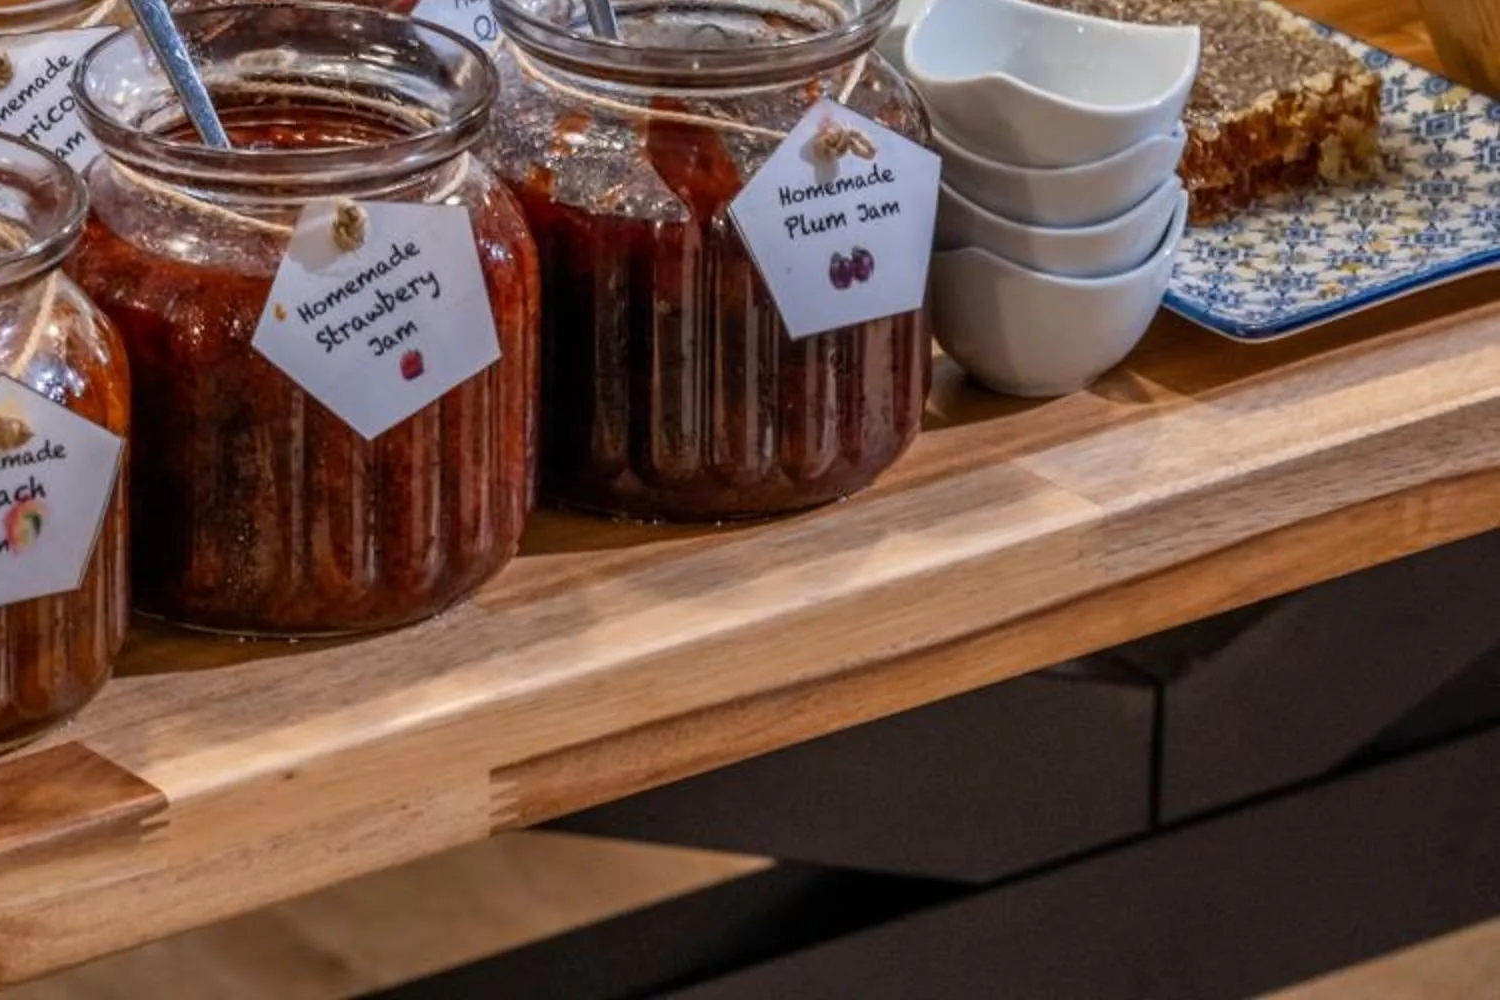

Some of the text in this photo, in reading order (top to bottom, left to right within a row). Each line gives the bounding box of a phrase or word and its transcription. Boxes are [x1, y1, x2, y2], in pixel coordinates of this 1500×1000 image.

[20, 94, 77, 141] rico
[55, 130, 87, 160] am
[778, 163, 896, 208] Homemade
[783, 200, 901, 239] Plum Jam
[297, 241, 421, 324] Homemade
[315, 271, 441, 354] Strawbery
[367, 320, 419, 357] Jam
